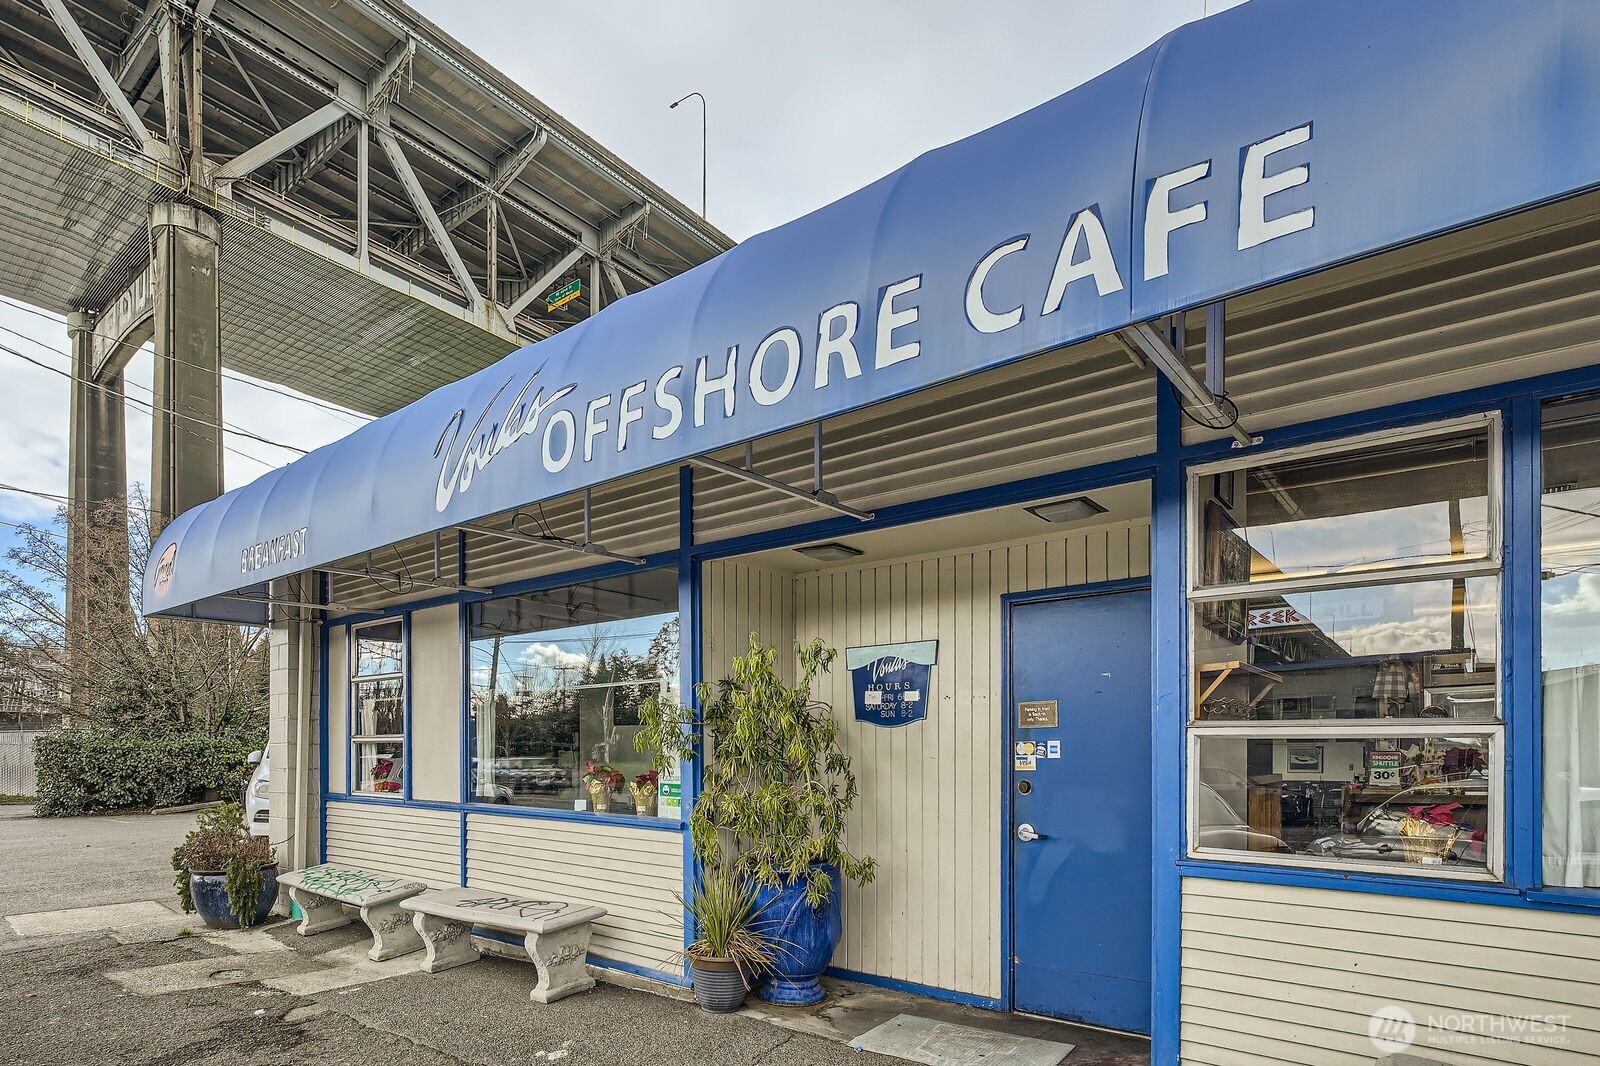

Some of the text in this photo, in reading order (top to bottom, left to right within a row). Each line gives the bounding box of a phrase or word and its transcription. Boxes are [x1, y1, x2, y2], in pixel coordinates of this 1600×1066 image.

[541, 273, 924, 474] OFFSHORE
[965, 120, 1316, 335] CAFE
[240, 527, 308, 574] BREAKFAST
[868, 681, 910, 691] HOURS
[865, 701, 914, 711] SATURDAY 8-2
[880, 710, 896, 718] SUN
[1373, 771, 1396, 780] 30¢
